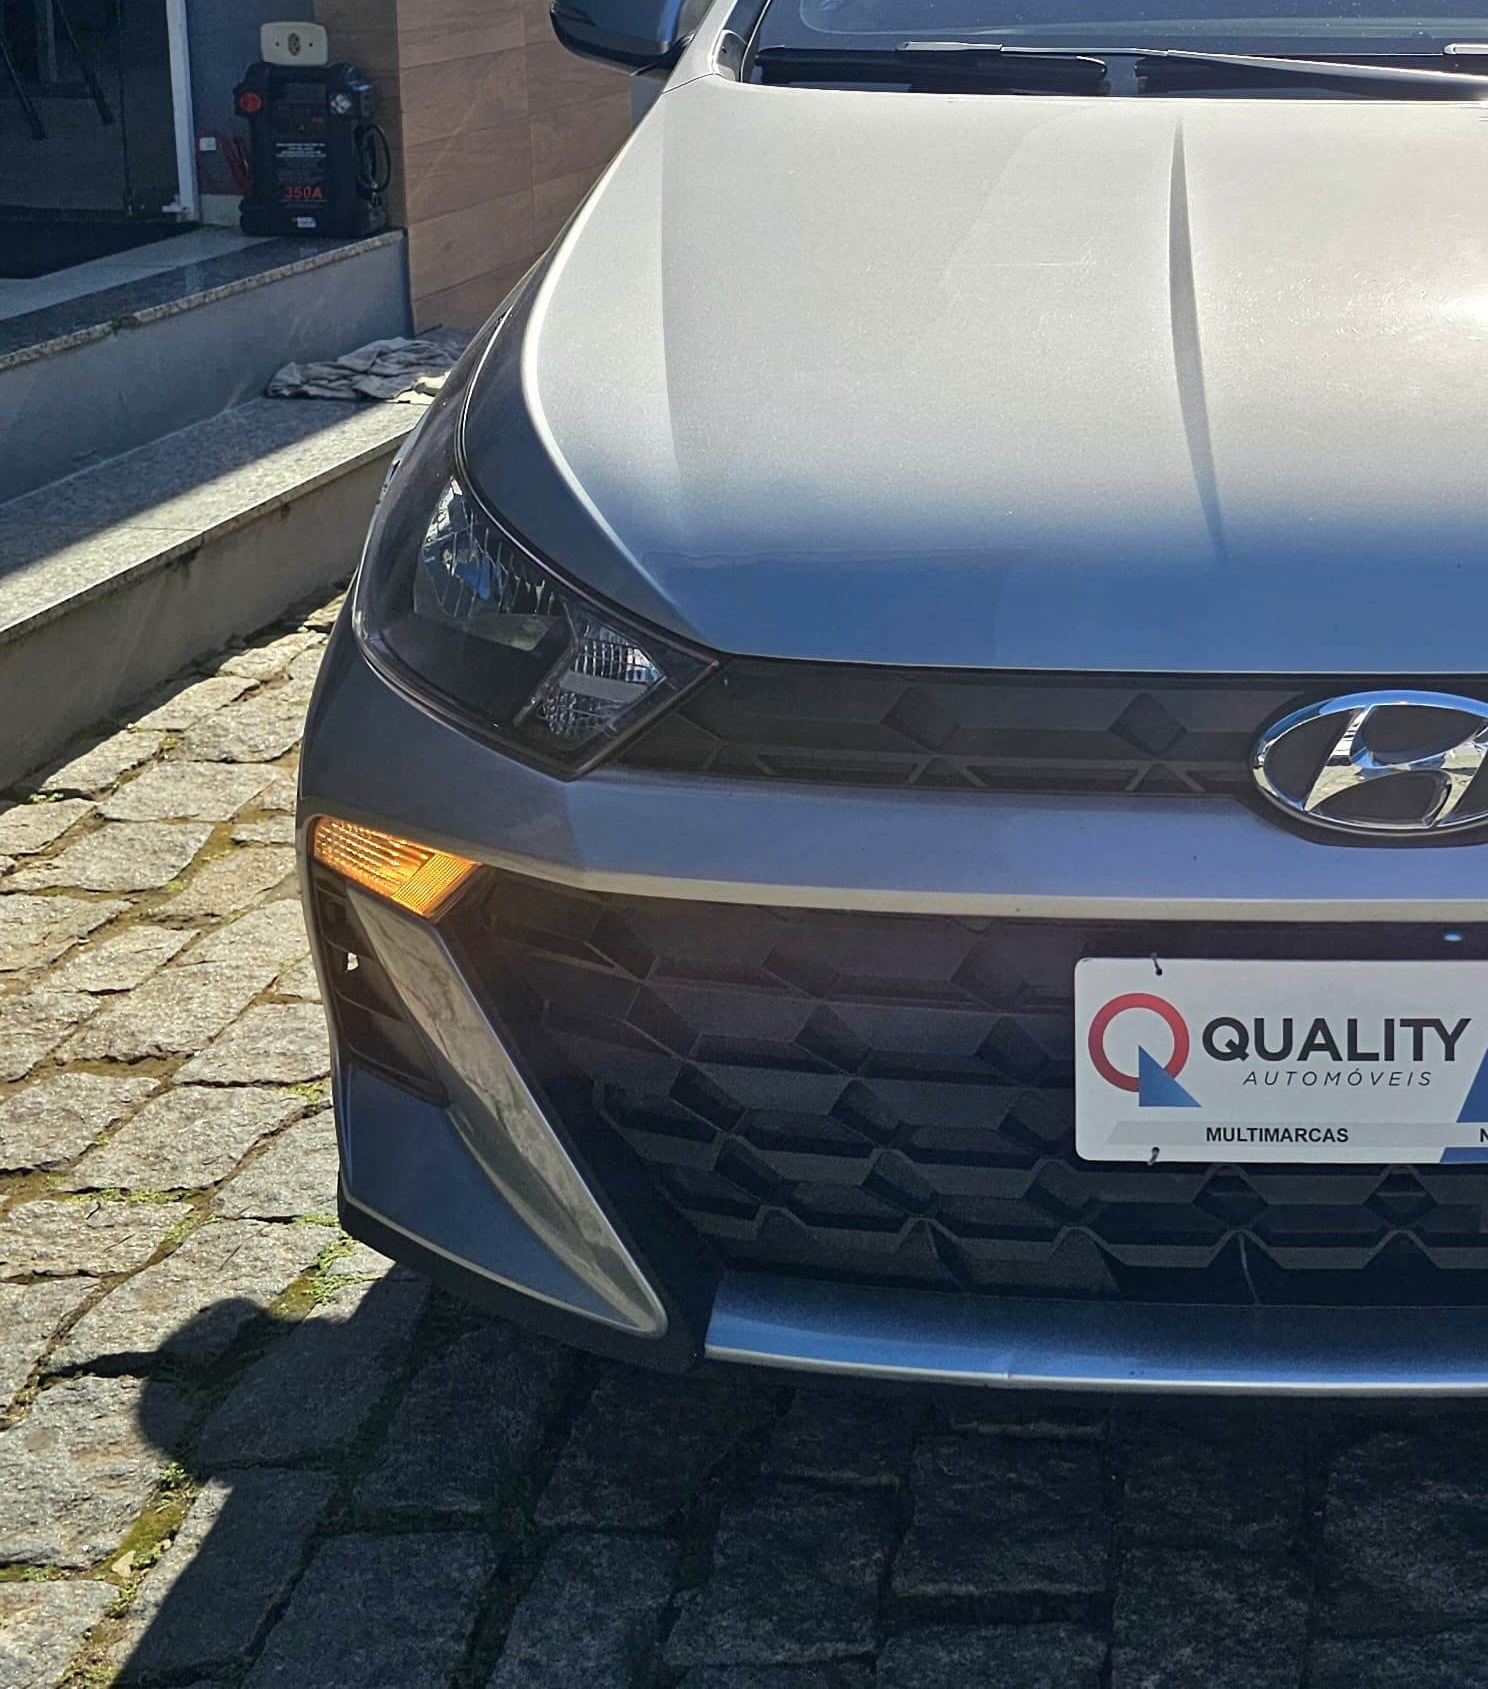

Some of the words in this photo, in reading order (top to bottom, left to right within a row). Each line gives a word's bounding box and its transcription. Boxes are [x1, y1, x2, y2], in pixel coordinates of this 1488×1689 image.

[284, 185, 324, 199] 350A
[1202, 1016, 1472, 1062] QUALITY
[1242, 1068, 1432, 1087] AUTOMÓVEIS
[1205, 1127, 1350, 1143] MULTIMARCAS
